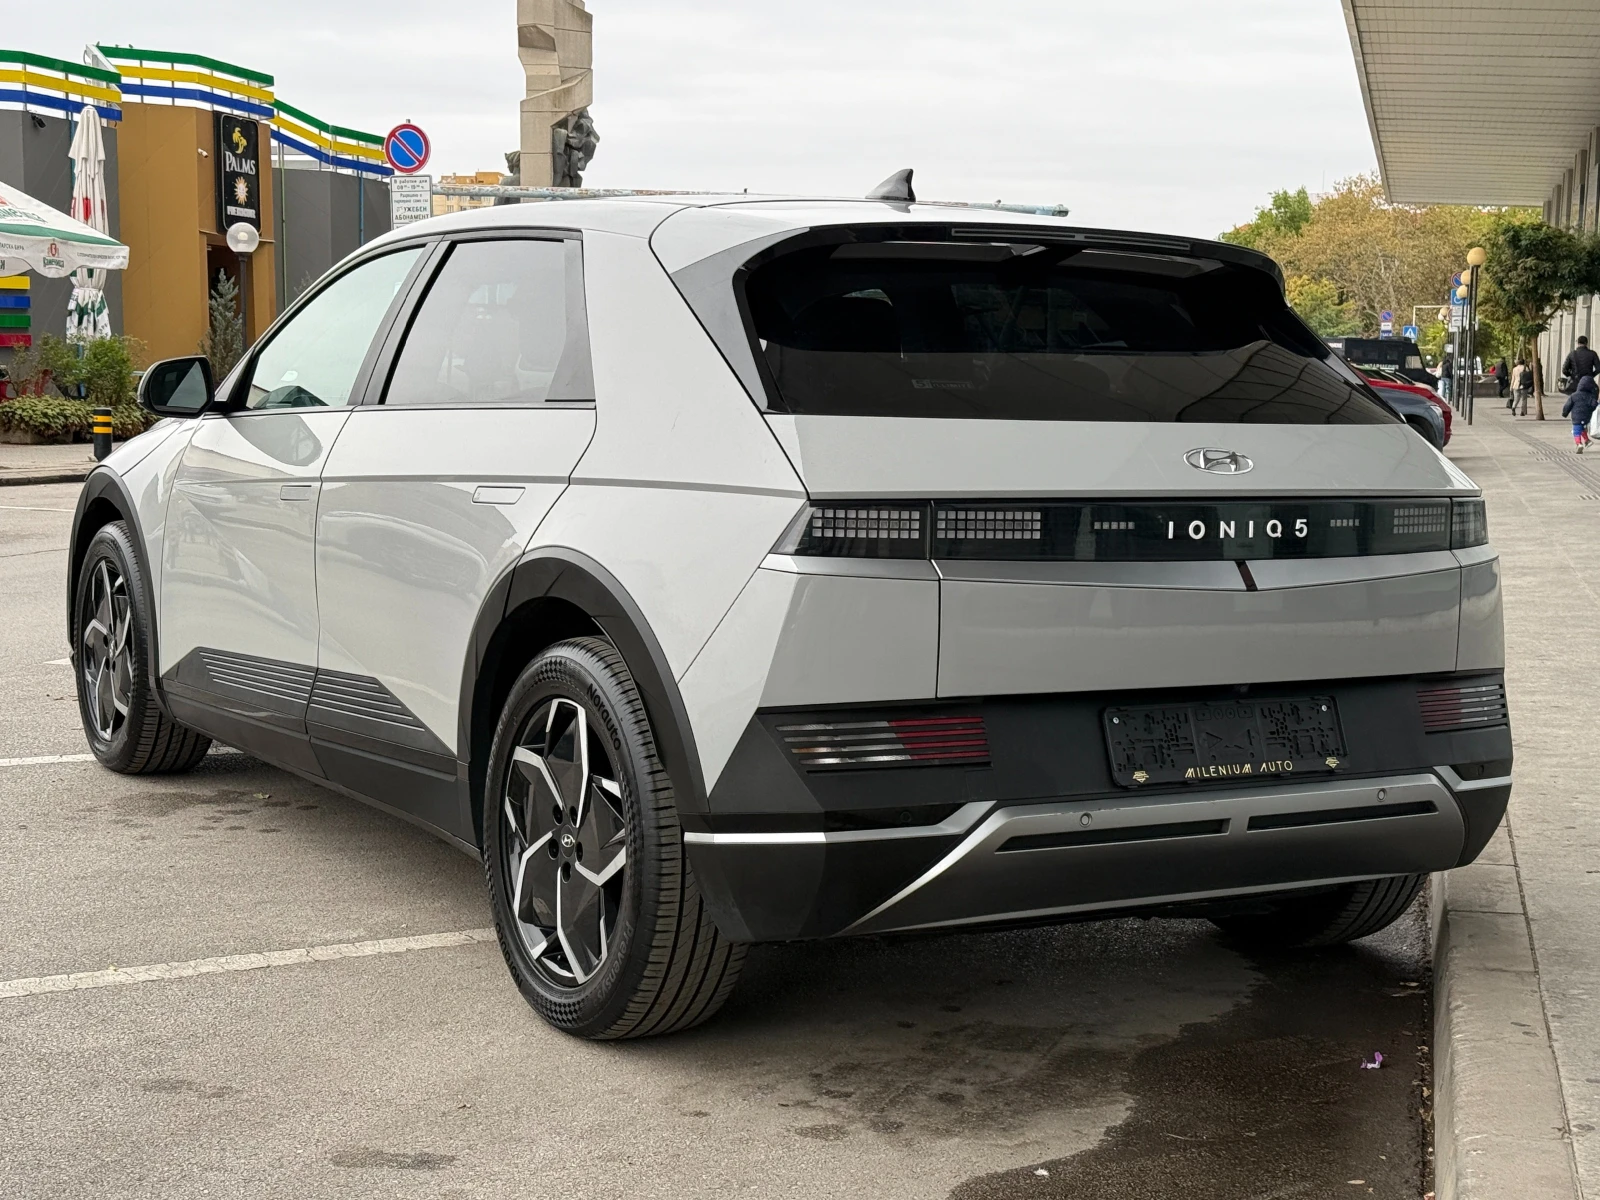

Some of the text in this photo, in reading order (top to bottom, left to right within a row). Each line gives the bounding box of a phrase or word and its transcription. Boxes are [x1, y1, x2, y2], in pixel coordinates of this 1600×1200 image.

[225, 151, 256, 175] PALMS
[586, 683, 622, 751] Norauto
[1184, 760, 1293, 779] MILENIUM AUTO
